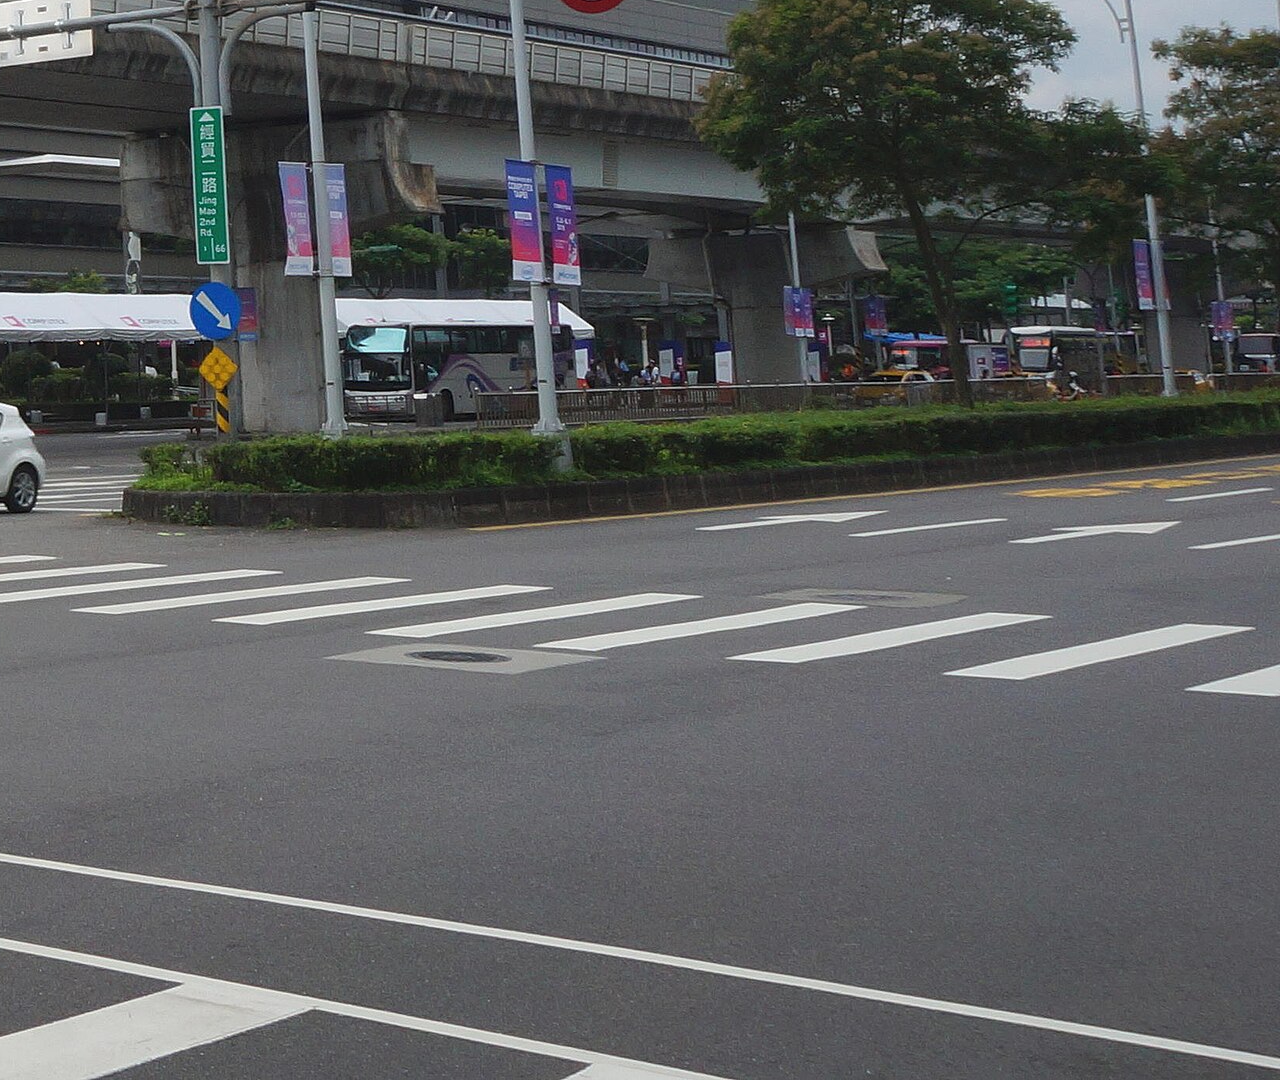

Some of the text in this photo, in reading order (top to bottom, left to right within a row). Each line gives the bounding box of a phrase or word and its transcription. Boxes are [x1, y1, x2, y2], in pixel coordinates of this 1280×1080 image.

[199, 123, 218, 194] 經貿二路
[198, 196, 217, 206] Jing
[199, 206, 217, 216] Mao
[199, 217, 216, 226] 2nd
[215, 244, 226, 253] 66
